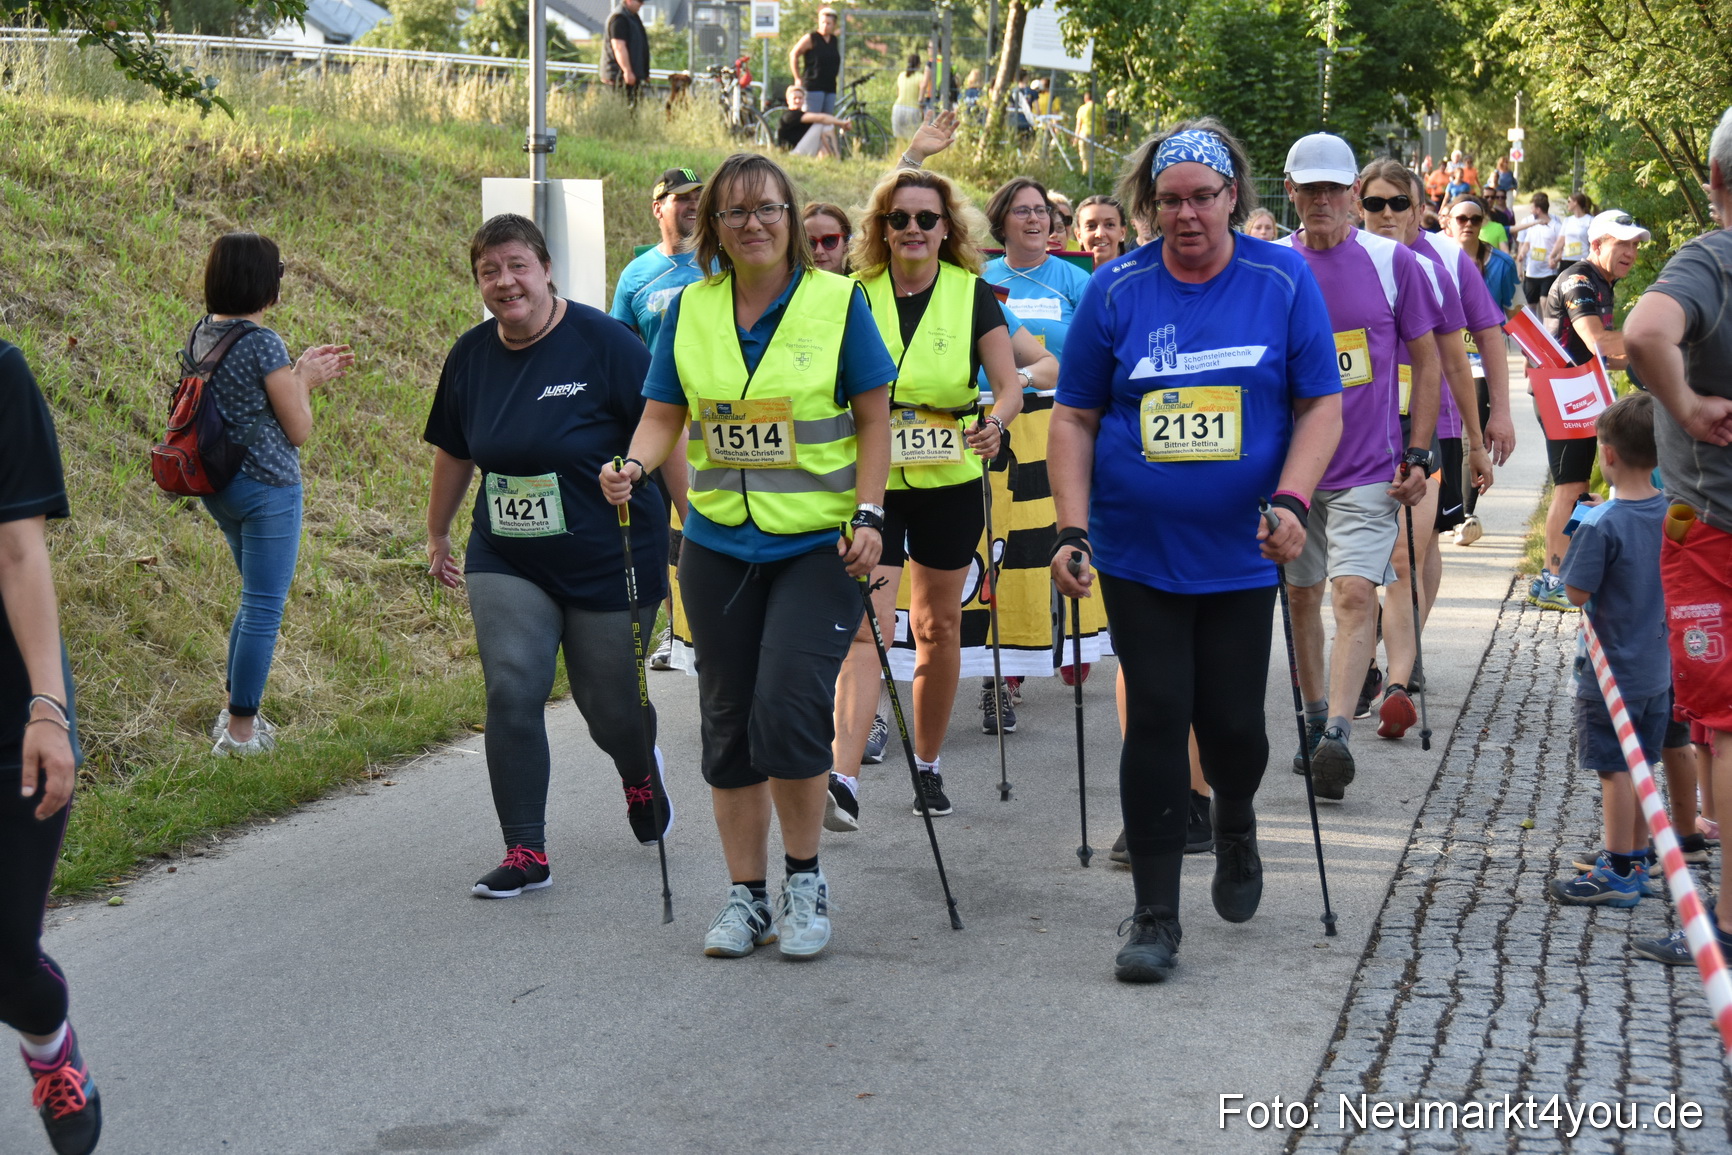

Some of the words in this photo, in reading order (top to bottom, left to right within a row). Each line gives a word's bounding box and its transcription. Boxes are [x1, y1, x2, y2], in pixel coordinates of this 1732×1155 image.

[1183, 349, 1252, 364] Schornsteintechnik
[1184, 360, 1220, 371] Neumarkt
[537, 384, 572, 400] JURA
[1155, 400, 1194, 410] firmenlauf
[1573, 400, 1586, 409] DEHN
[711, 412, 746, 421] firmenlauf
[1152, 413, 1224, 441] 2131
[712, 423, 782, 450] 1514
[896, 428, 954, 450] 1512
[714, 448, 750, 457] Gottschalk
[751, 449, 784, 457] Christine
[494, 496, 548, 520] 1421
[632, 622, 643, 656] ELITE
[636, 658, 648, 707] CARBON
